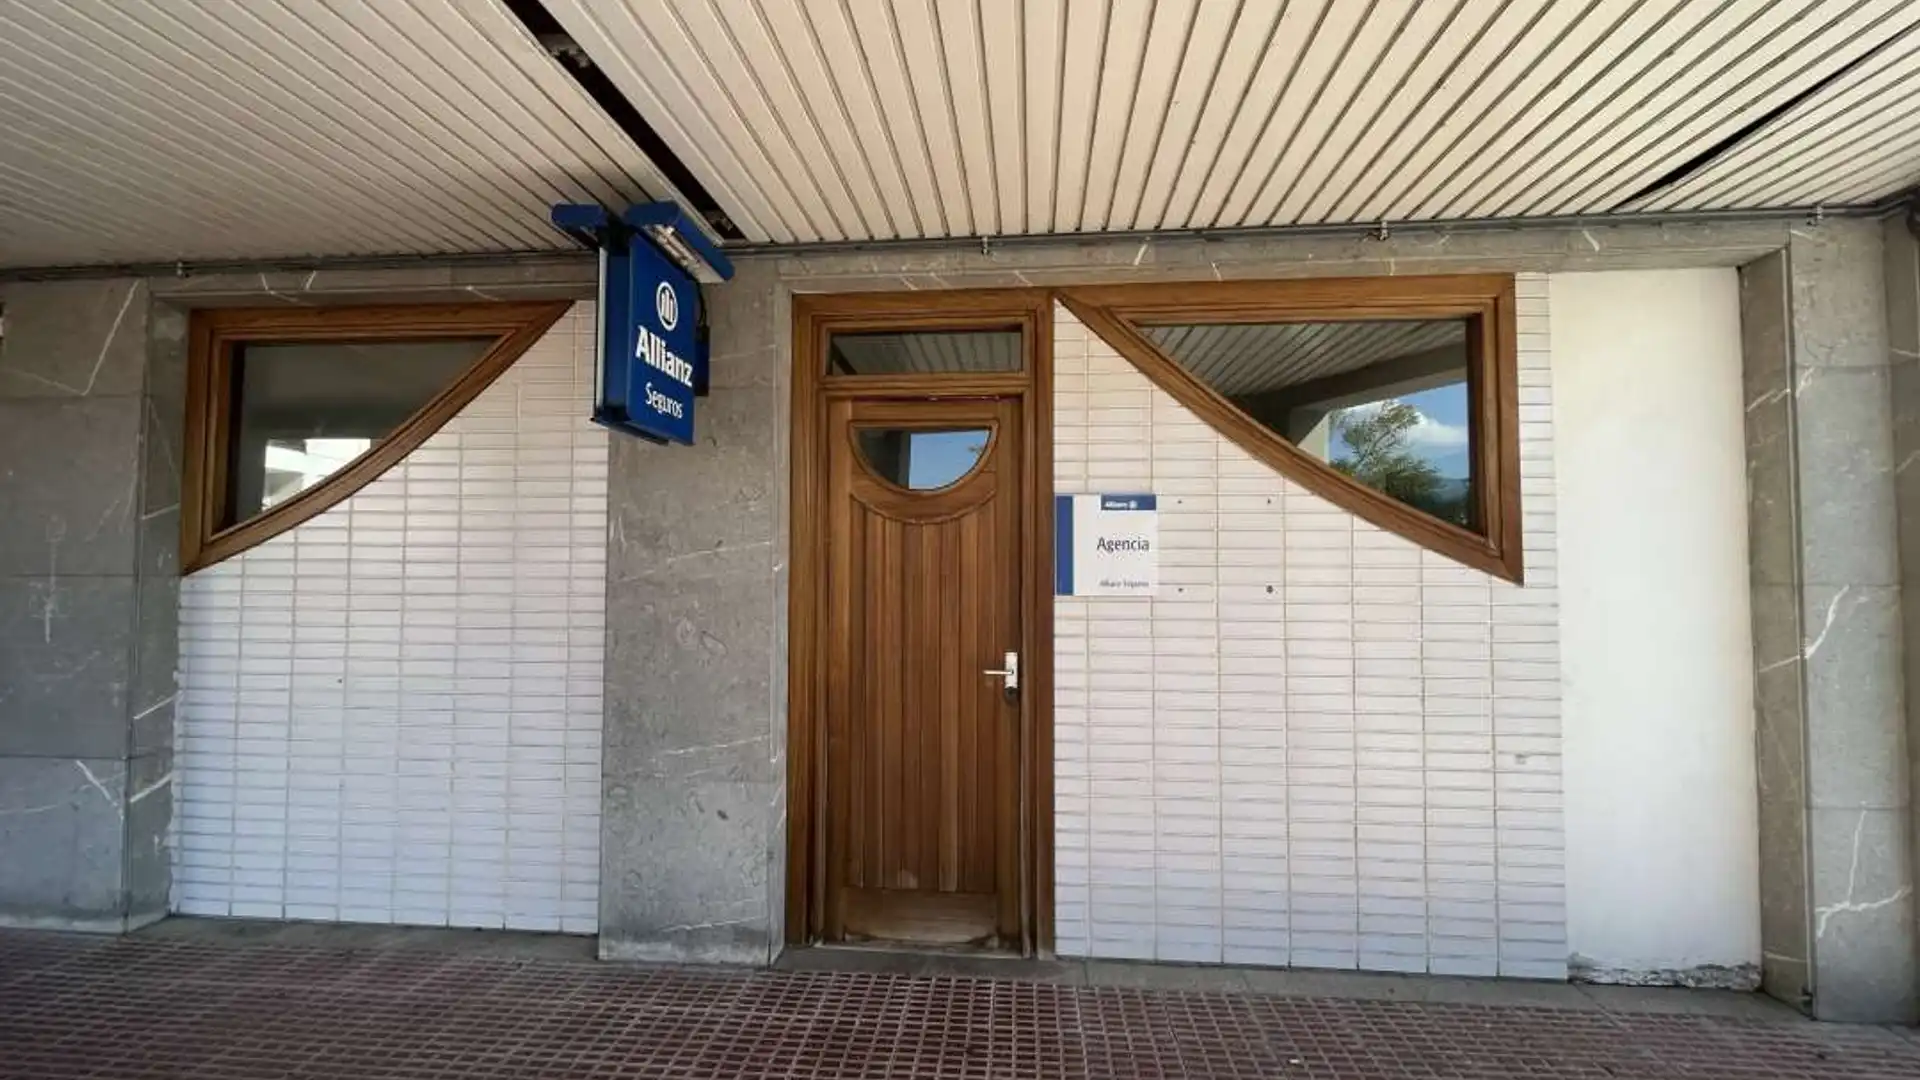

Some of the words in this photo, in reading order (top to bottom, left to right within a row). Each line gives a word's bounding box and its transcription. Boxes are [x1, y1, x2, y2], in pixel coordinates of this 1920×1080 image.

[635, 325, 693, 387] Allianz
[645, 382, 683, 419] Seguros
[1096, 536, 1150, 553] Agencia
